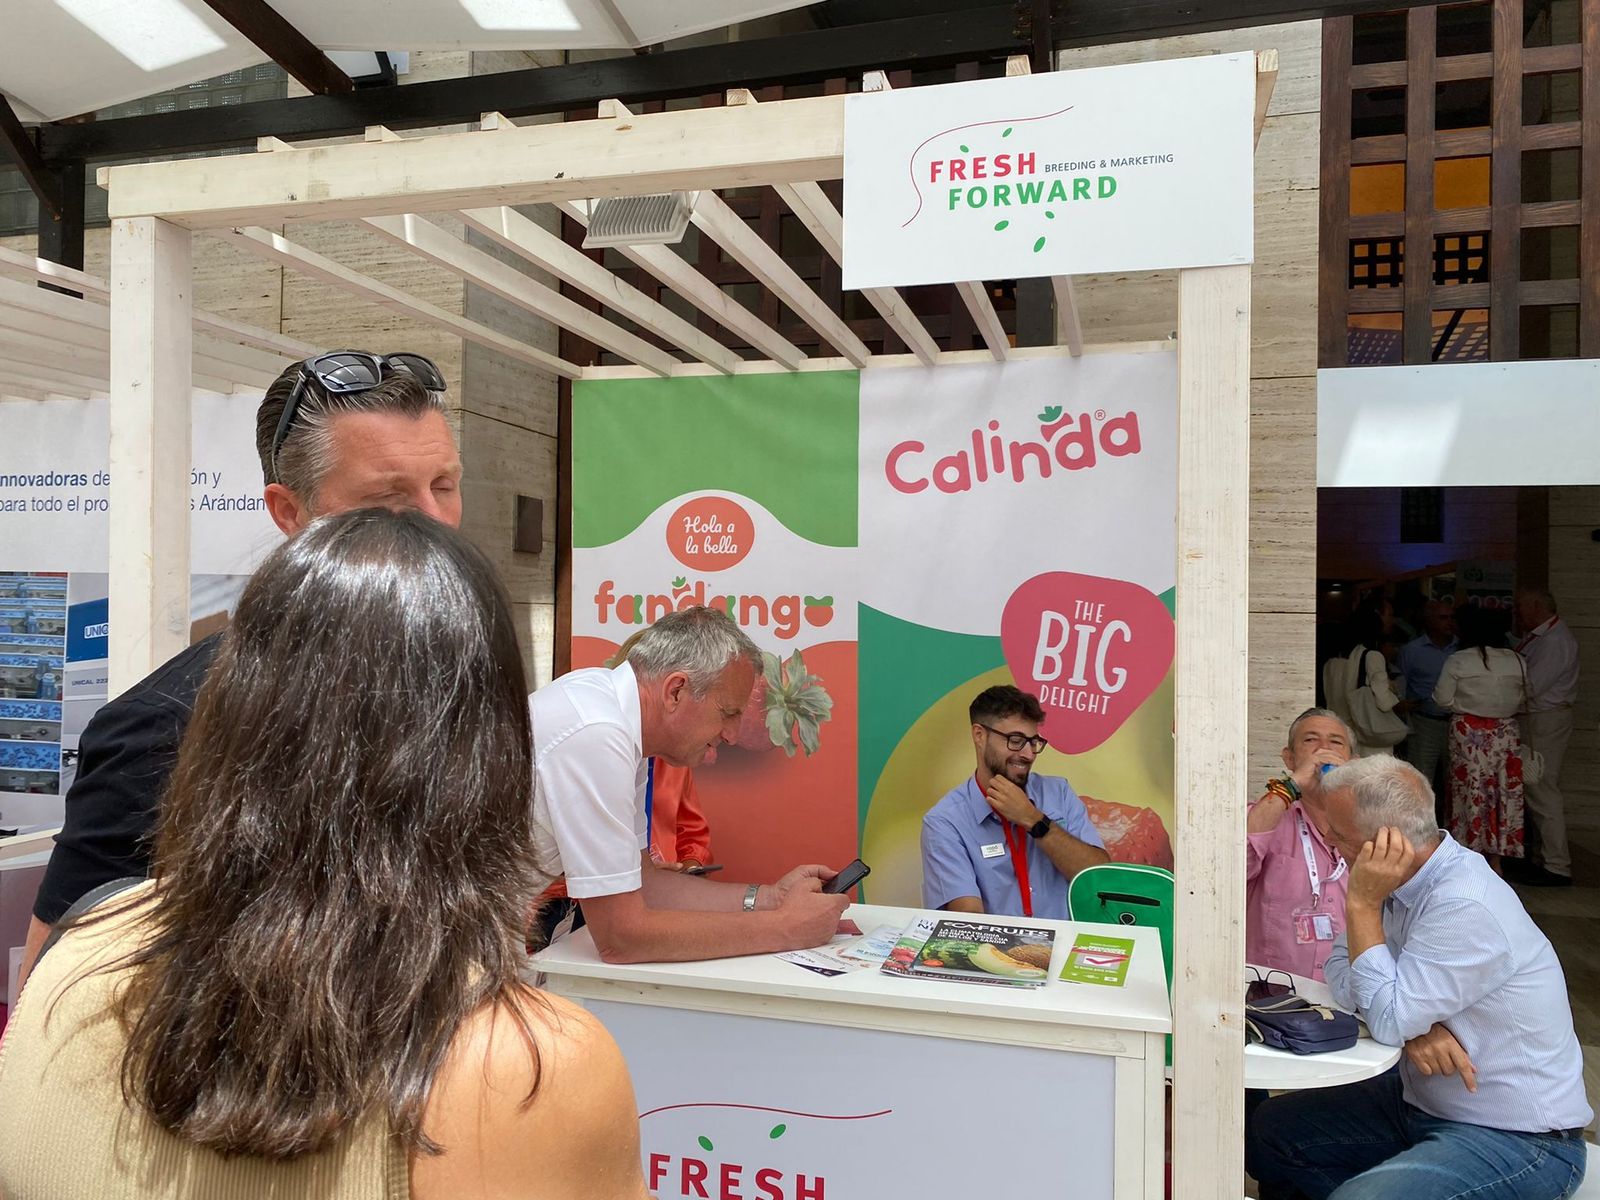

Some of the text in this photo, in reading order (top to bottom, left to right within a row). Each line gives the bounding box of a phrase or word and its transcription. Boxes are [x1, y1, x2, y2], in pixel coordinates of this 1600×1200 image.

[930, 152, 1174, 183] FRESH BREEDING & MARKETING
[948, 175, 1117, 210] FORWARD
[212, 472, 222, 489] y
[30, 495, 63, 512] todo
[66, 495, 80, 512] el
[84, 499, 109, 515] pro
[682, 515, 735, 534] Hola a
[685, 535, 738, 554] la bella
[1074, 599, 1106, 624] THE
[1031, 609, 1132, 694] BIG
[1039, 684, 1111, 715] DELIGHT
[649, 1153, 825, 1200] FRESH
